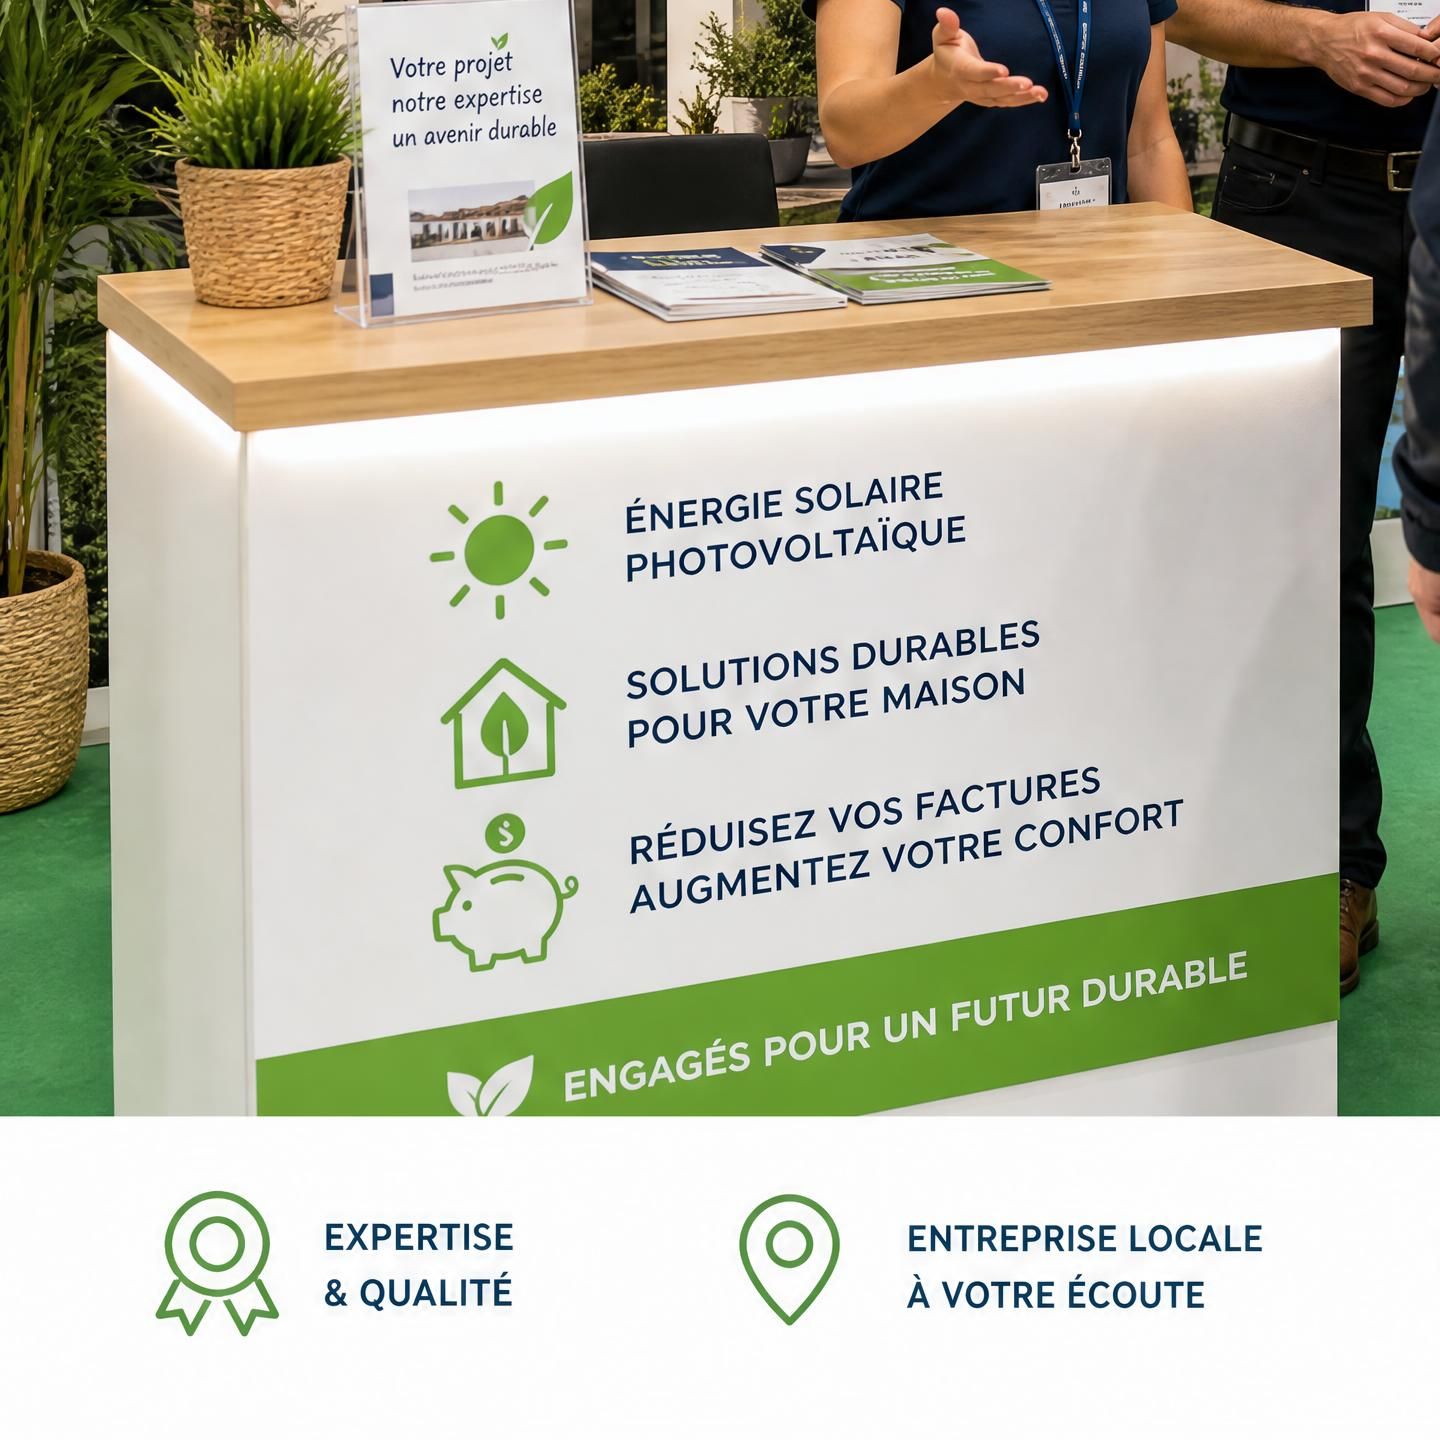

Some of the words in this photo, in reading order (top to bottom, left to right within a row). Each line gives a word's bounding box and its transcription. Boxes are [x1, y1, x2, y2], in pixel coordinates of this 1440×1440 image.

[390, 57, 446, 79] Votre
[454, 51, 513, 82] projet
[392, 92, 446, 113] notre
[454, 84, 543, 114] expertise
[393, 133, 416, 148] un
[424, 123, 482, 145] avenir
[489, 114, 557, 141] durable
[627, 490, 782, 534] ÉNERGIE
[796, 472, 942, 514] SOLAIRE
[627, 516, 965, 582] PHOTOVOLTAÏQUE
[627, 646, 839, 699] SOLUTIONS
[854, 620, 1039, 670] DURABLES
[629, 709, 732, 748] POUR
[746, 689, 868, 730] VOTRE
[884, 668, 1024, 713] MAISON
[631, 810, 816, 864] RÉDUISEZ
[829, 797, 902, 832] VOS
[917, 767, 1100, 820] FACTURES
[630, 850, 870, 913] AUGMENTEZ
[882, 829, 1002, 872] VOTRE
[1015, 799, 1183, 851] CONFORT
[565, 1038, 750, 1102] ENGAGÉS
[765, 1021, 870, 1066] POUR
[884, 1008, 936, 1042] UN
[952, 985, 1070, 1031] FUTUR
[1083, 951, 1247, 1007] DURABLE
